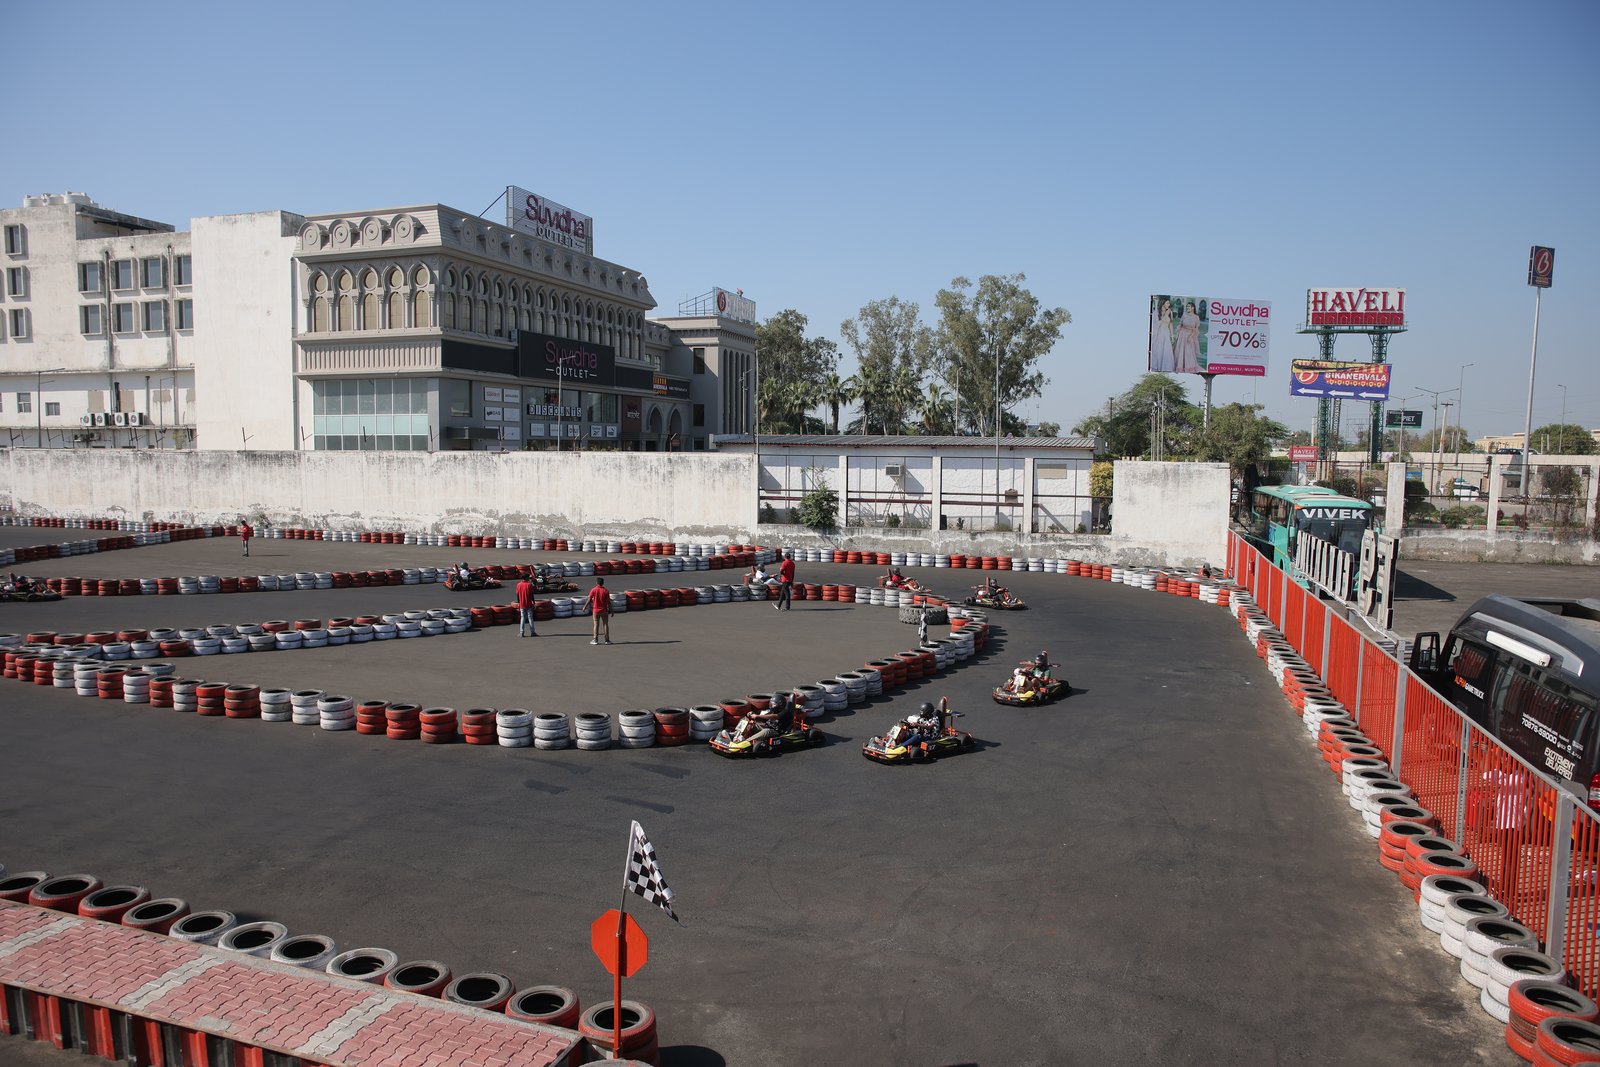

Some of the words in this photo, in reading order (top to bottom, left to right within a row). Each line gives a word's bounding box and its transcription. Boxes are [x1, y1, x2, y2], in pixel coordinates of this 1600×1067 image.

[526, 194, 585, 239] Suvidha
[536, 226, 574, 248] OUTLET
[1210, 302, 1269, 318] Suvidha
[1311, 288, 1405, 311] HAVELI
[1221, 318, 1257, 327] OUTLET
[1218, 330, 1260, 349] 70%
[545, 340, 598, 369] Suvidha
[555, 366, 589, 379] OUTLET
[1301, 508, 1367, 519] VIVEK
[1544, 746, 1576, 772] EXCITEMENT
[1545, 757, 1573, 781] DELIVERED
